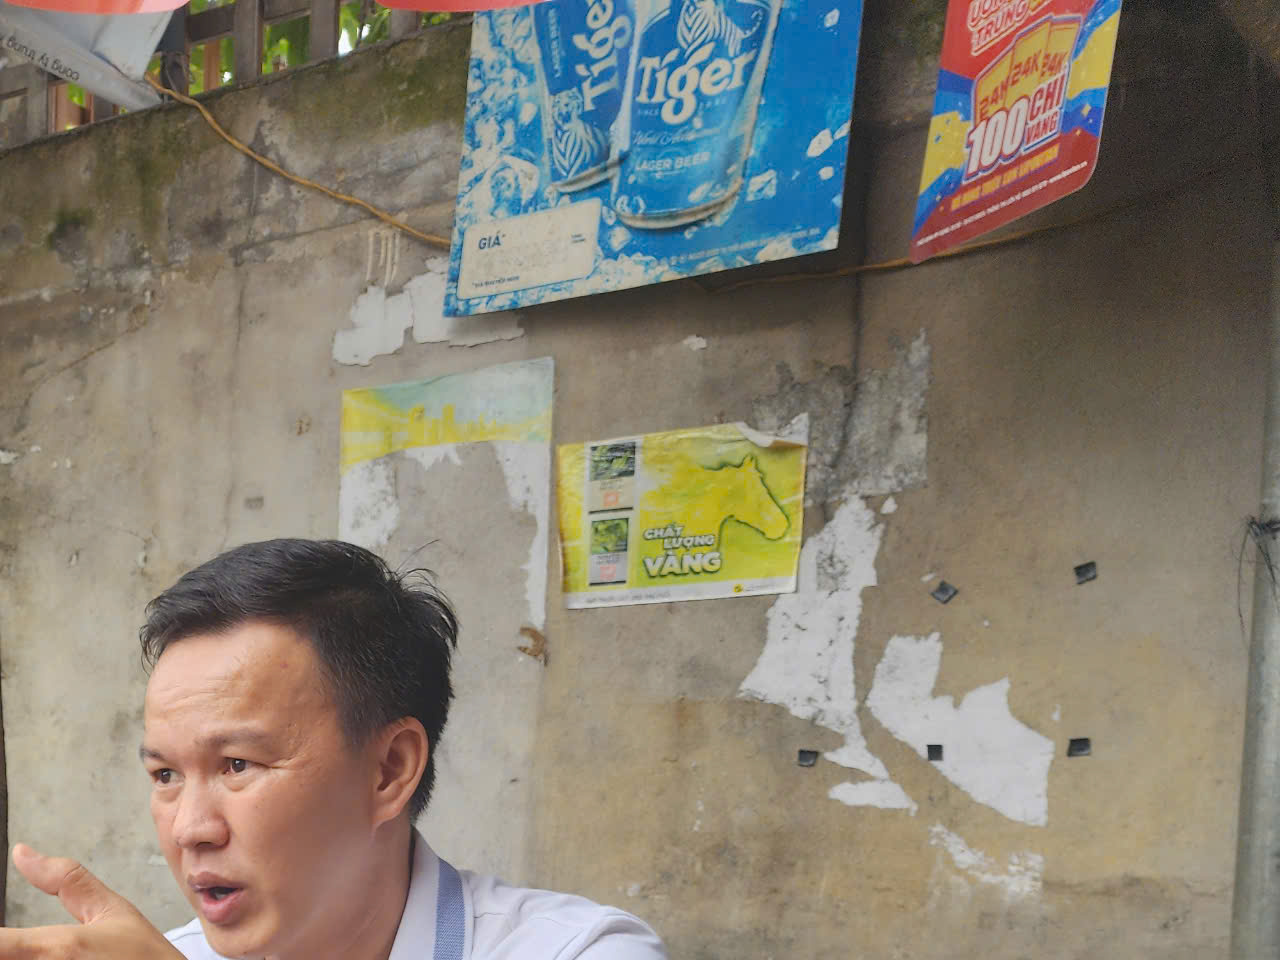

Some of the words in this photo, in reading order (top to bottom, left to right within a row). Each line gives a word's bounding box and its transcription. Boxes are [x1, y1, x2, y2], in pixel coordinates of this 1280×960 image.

[573, 0, 631, 112] Tige
[635, 41, 757, 125] Tiger
[967, 95, 1031, 176] 100
[642, 550, 723, 578] VÀNG
